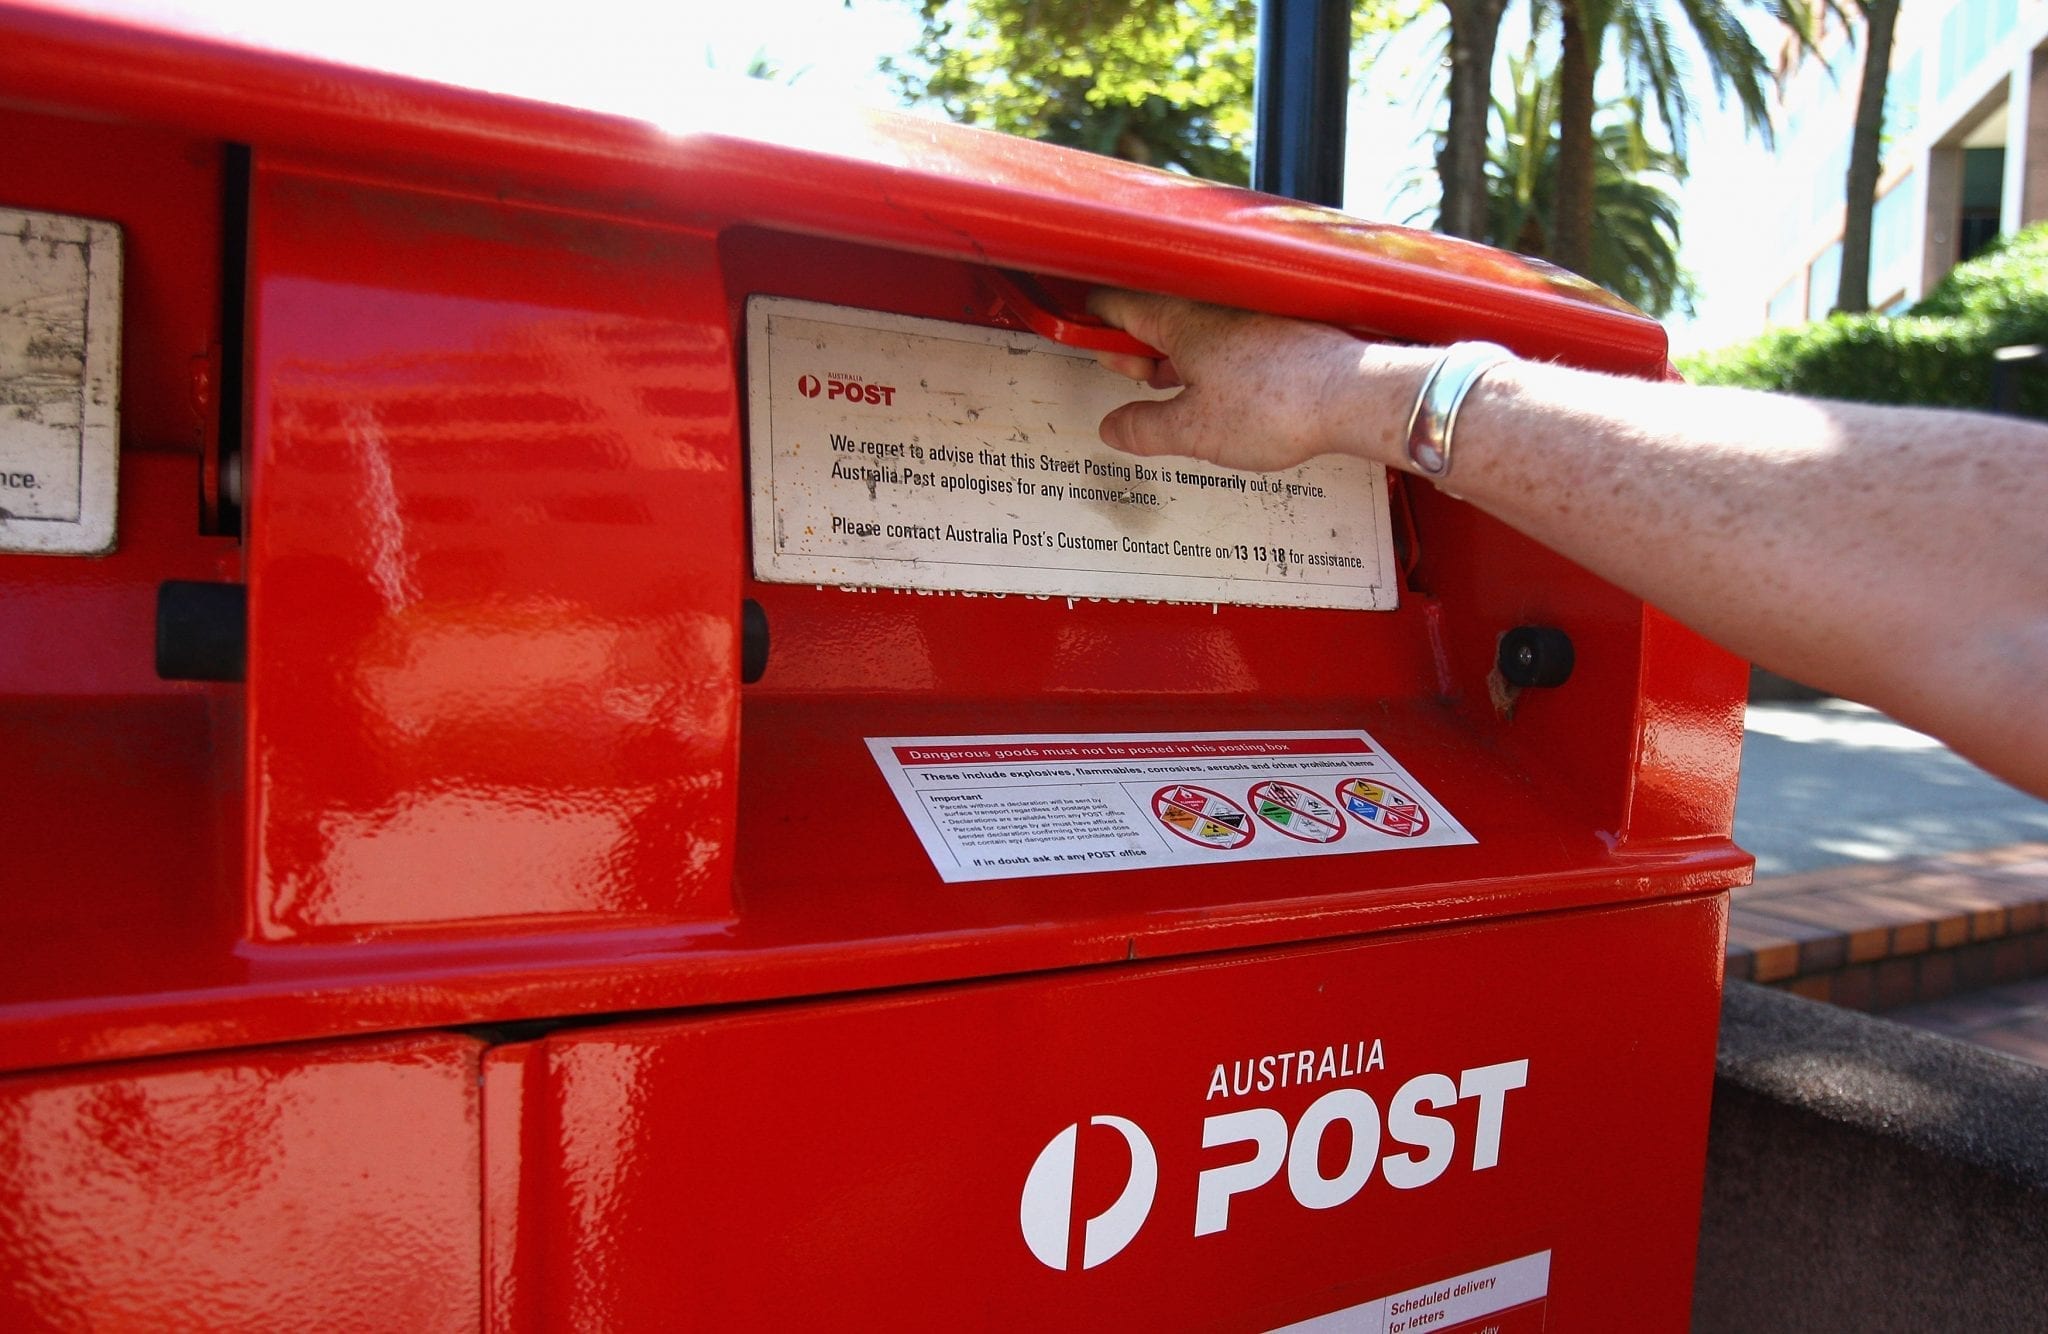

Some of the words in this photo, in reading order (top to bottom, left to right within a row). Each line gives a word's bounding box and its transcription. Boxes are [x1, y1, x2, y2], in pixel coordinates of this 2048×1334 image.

[828, 372, 863, 382] AUSTRALIA
[828, 381, 896, 406] POST
[830, 434, 855, 452] We
[861, 439, 904, 458] regret
[909, 444, 924, 458] to
[929, 446, 974, 464] advise
[978, 449, 1006, 467] that
[1010, 452, 1036, 470] this
[1040, 455, 1080, 475] Street
[1085, 459, 1130, 481] Posting
[1135, 465, 1158, 481] Box
[1161, 467, 1172, 483] is
[1175, 470, 1247, 493] temporarily
[1250, 478, 1268, 493] out
[1271, 479, 1283, 494] of
[1286, 483, 1326, 498] service.
[831, 462, 899, 484] Australia
[904, 468, 936, 487] Post
[940, 471, 1013, 495] apologises
[1017, 479, 1036, 496] for
[1040, 485, 1063, 501] any
[1068, 483, 1160, 506] inconvenence.
[832, 517, 881, 537] Please
[886, 523, 941, 541] contact
[945, 525, 1007, 545] Australia
[1013, 529, 1054, 548] Post's
[1058, 532, 1118, 551] Customer
[1122, 537, 1169, 556] Contact
[1173, 541, 1212, 558] Centre
[1215, 547, 1229, 559] on
[1234, 545, 1248, 560] 13
[1253, 546, 1267, 562] 13
[1272, 548, 1286, 563] 18
[1289, 549, 1304, 565] for
[1308, 552, 1365, 568] assistance.
[909, 750, 991, 760] Dangerous
[995, 748, 1039, 759] goods
[1042, 747, 1079, 756] must
[1081, 747, 1106, 755] not
[1128, 746, 1174, 755] posted
[1176, 745, 1190, 753] in
[1191, 744, 1216, 753] this
[1219, 743, 1265, 753] posting
[1265, 743, 1290, 751] box
[921, 773, 960, 781] These
[962, 771, 1007, 780] include
[1010, 768, 1075, 778] explosives,
[1076, 767, 1146, 776] flammables,
[1147, 765, 1206, 774] corrosives,
[1207, 763, 1250, 771] aerosols
[1251, 762, 1270, 770] and
[1272, 761, 1298, 769] other
[1300, 760, 1348, 770] prohibited
[1348, 759, 1374, 767] items
[930, 794, 983, 802] Important
[998, 856, 1030, 865] doubt
[1032, 855, 1052, 863] ask
[1066, 853, 1086, 861] any
[1087, 850, 1117, 859] POST
[1119, 849, 1148, 857] office
[1206, 1038, 1386, 1101] AUSTRALIA
[1194, 1058, 1529, 1238] POST
[1391, 1287, 1451, 1316] Scheduled
[1453, 1276, 1497, 1298] delivery
[1389, 1321, 1406, 1334] for
[1408, 1310, 1445, 1329] letters
